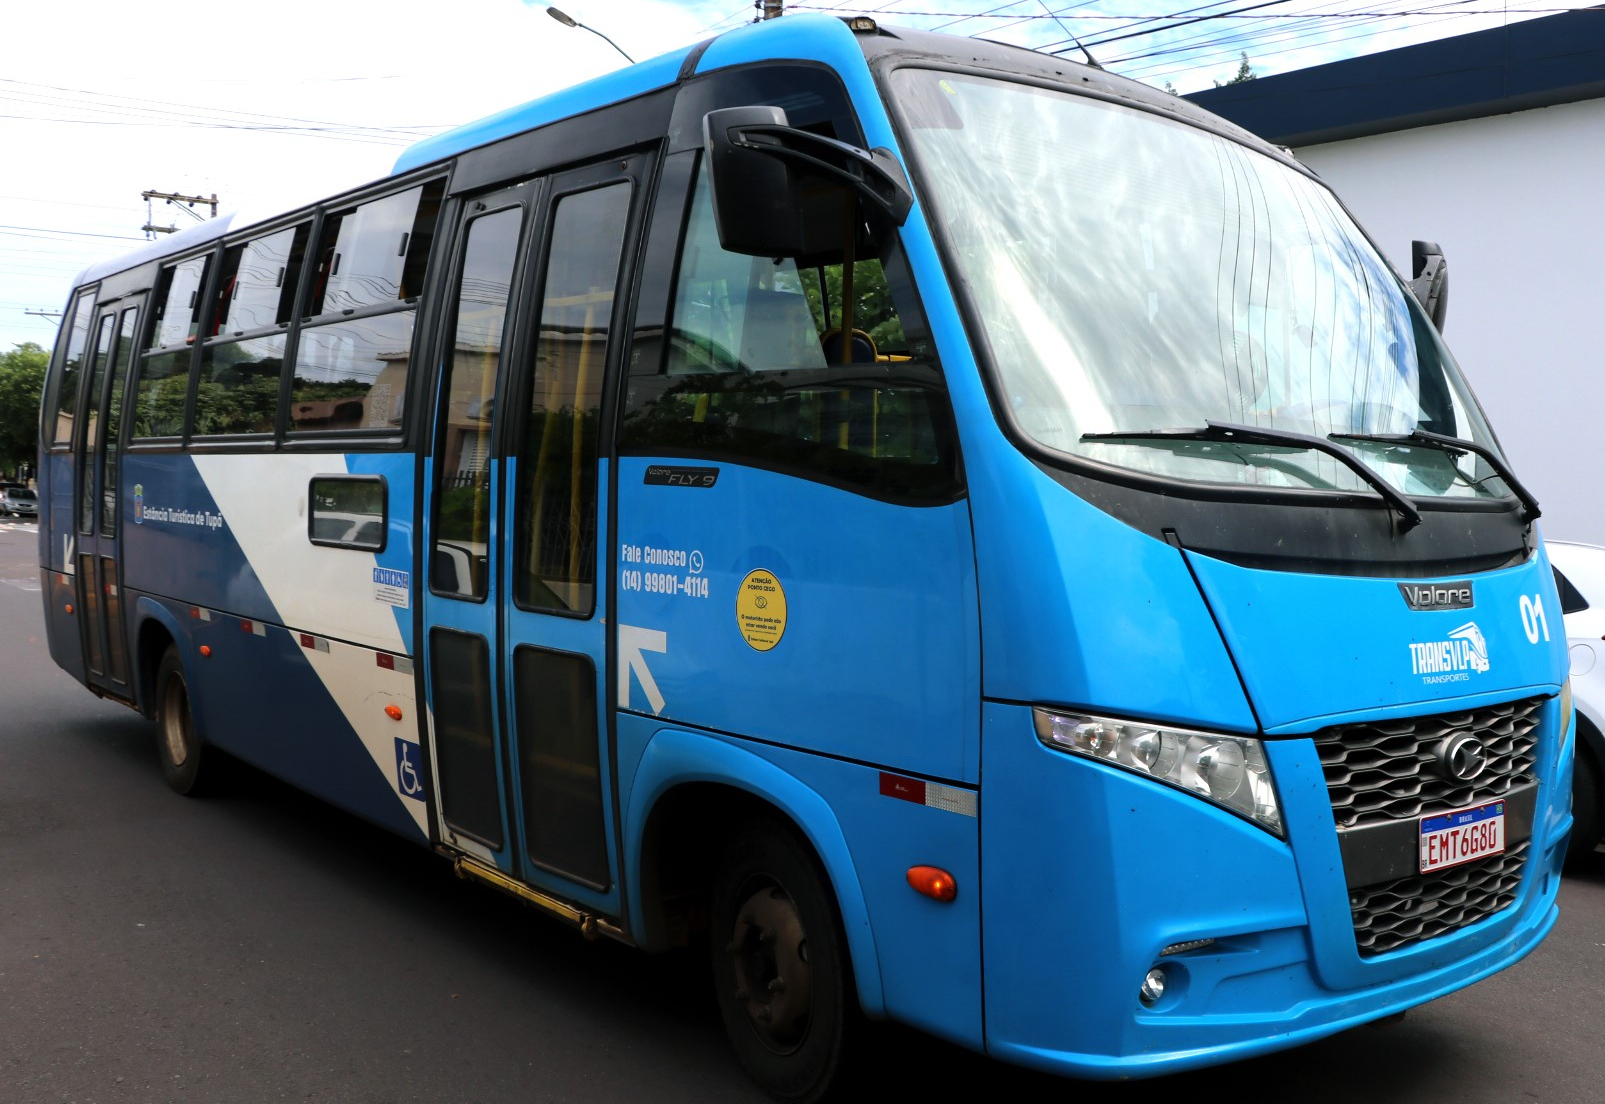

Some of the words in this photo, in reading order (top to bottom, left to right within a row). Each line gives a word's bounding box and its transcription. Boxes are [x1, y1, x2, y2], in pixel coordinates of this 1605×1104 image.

[668, 474, 699, 485] FLY
[703, 475, 715, 486] 9
[196, 510, 204, 526] de
[622, 544, 641, 563] Fale
[644, 545, 686, 567] Conosco
[622, 569, 641, 592] (14)
[644, 571, 709, 599] 99801-4114
[1404, 585, 1471, 607] Volare
[1519, 593, 1550, 644] 01
[1409, 640, 1471, 675] TRANSVLP
[1422, 673, 1470, 684] TRANSPORTES
[1459, 815, 1473, 823] BRASIL
[1429, 821, 1496, 865] EMT6G80
